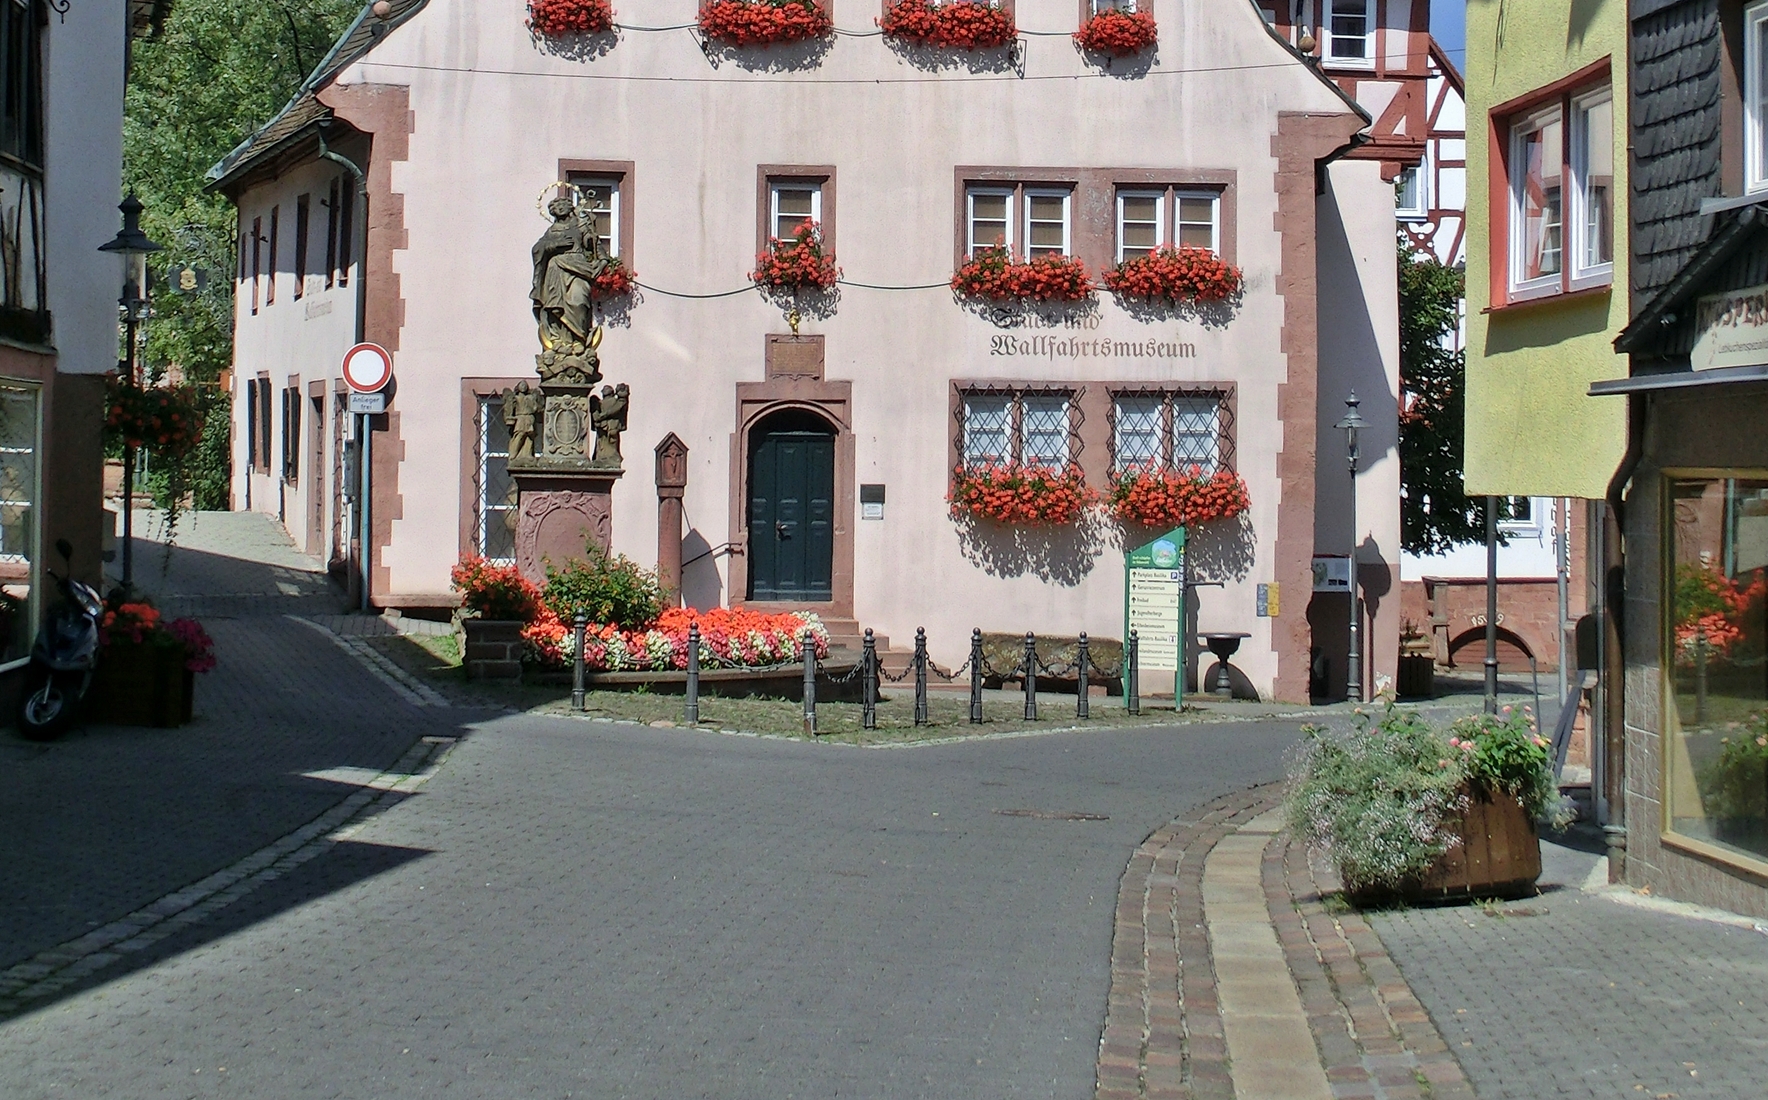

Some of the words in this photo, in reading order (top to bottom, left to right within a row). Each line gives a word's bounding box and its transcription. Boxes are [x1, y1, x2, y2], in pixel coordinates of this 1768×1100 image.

[990, 334, 1197, 361] Wallfahrtsmuseum
[352, 395, 380, 404] Anlieger
[1470, 614, 1504, 627] 159
